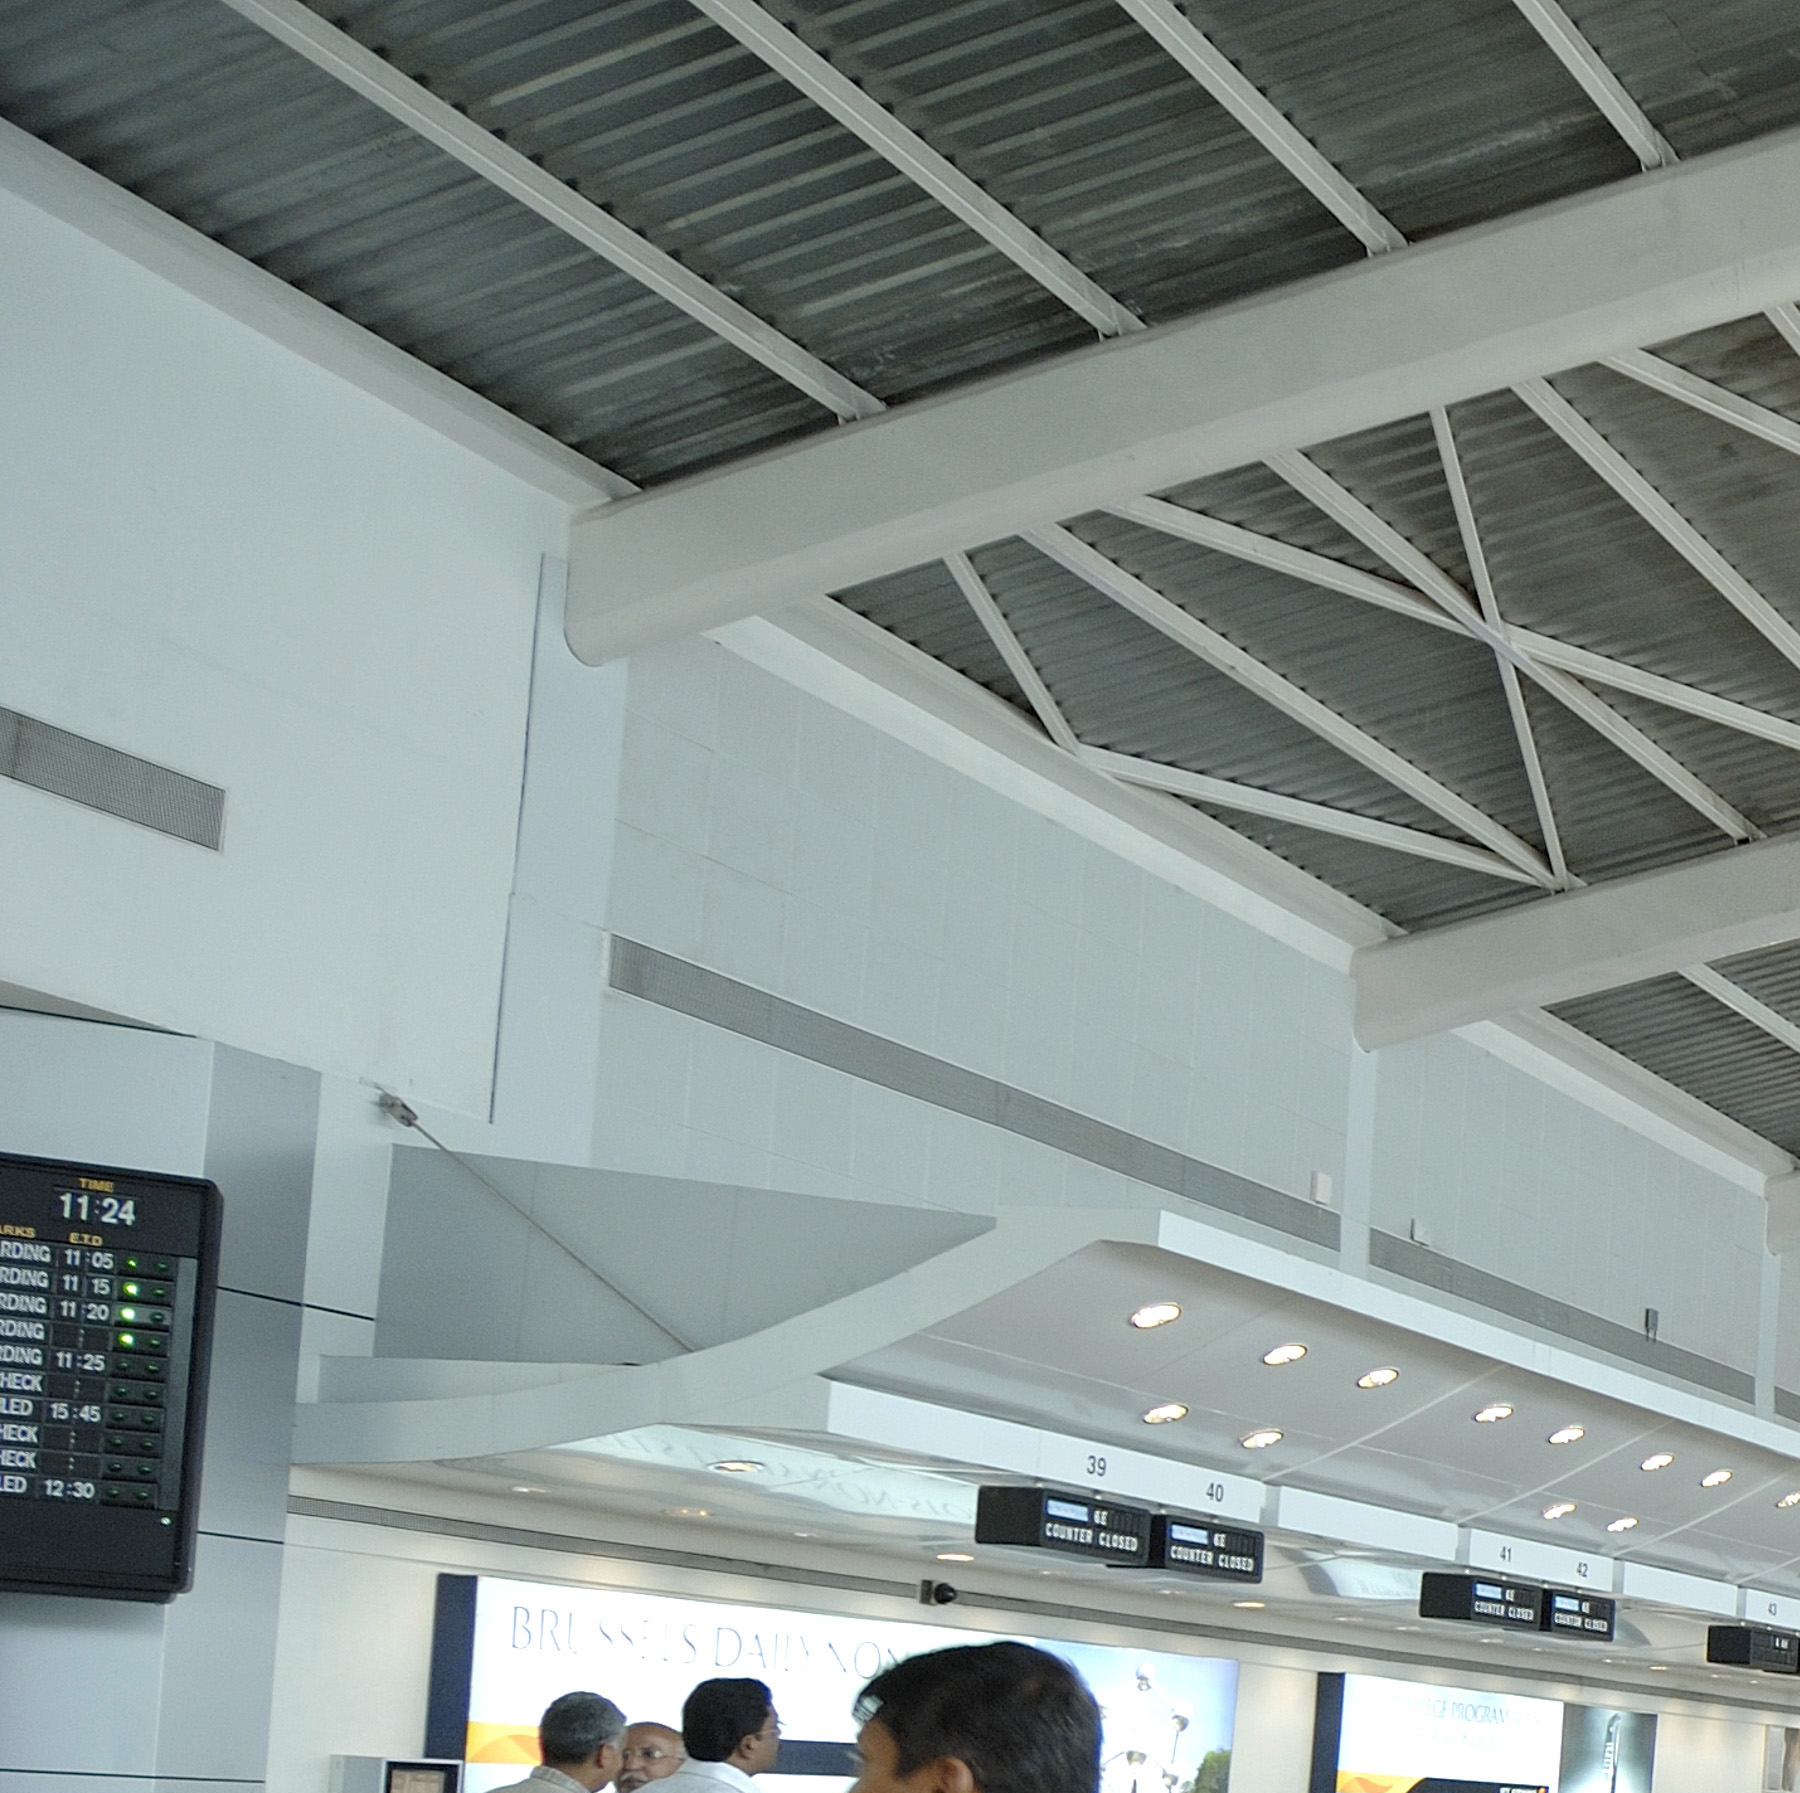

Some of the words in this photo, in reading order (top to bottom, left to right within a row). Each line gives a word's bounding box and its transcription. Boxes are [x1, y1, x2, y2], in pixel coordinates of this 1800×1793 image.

[79, 1177, 115, 1193] TIME
[60, 1193, 136, 1226] 11:24
[65, 1249, 114, 1269] 11:05
[60, 1300, 109, 1321] 11:20
[56, 1351, 105, 1371] 11:25
[50, 1402, 101, 1422] 15:45
[1086, 1454, 1107, 1477] 39
[44, 1478, 96, 1499] 12:30
[1205, 1482, 1225, 1503] 40
[1045, 1523, 1093, 1544] COUNTER
[1098, 1531, 1138, 1552] CLOSED
[1170, 1545, 1214, 1566] COUNTER
[1218, 1553, 1254, 1572] CLOSED
[1499, 1546, 1512, 1562] 41
[1576, 1561, 1588, 1577] 42
